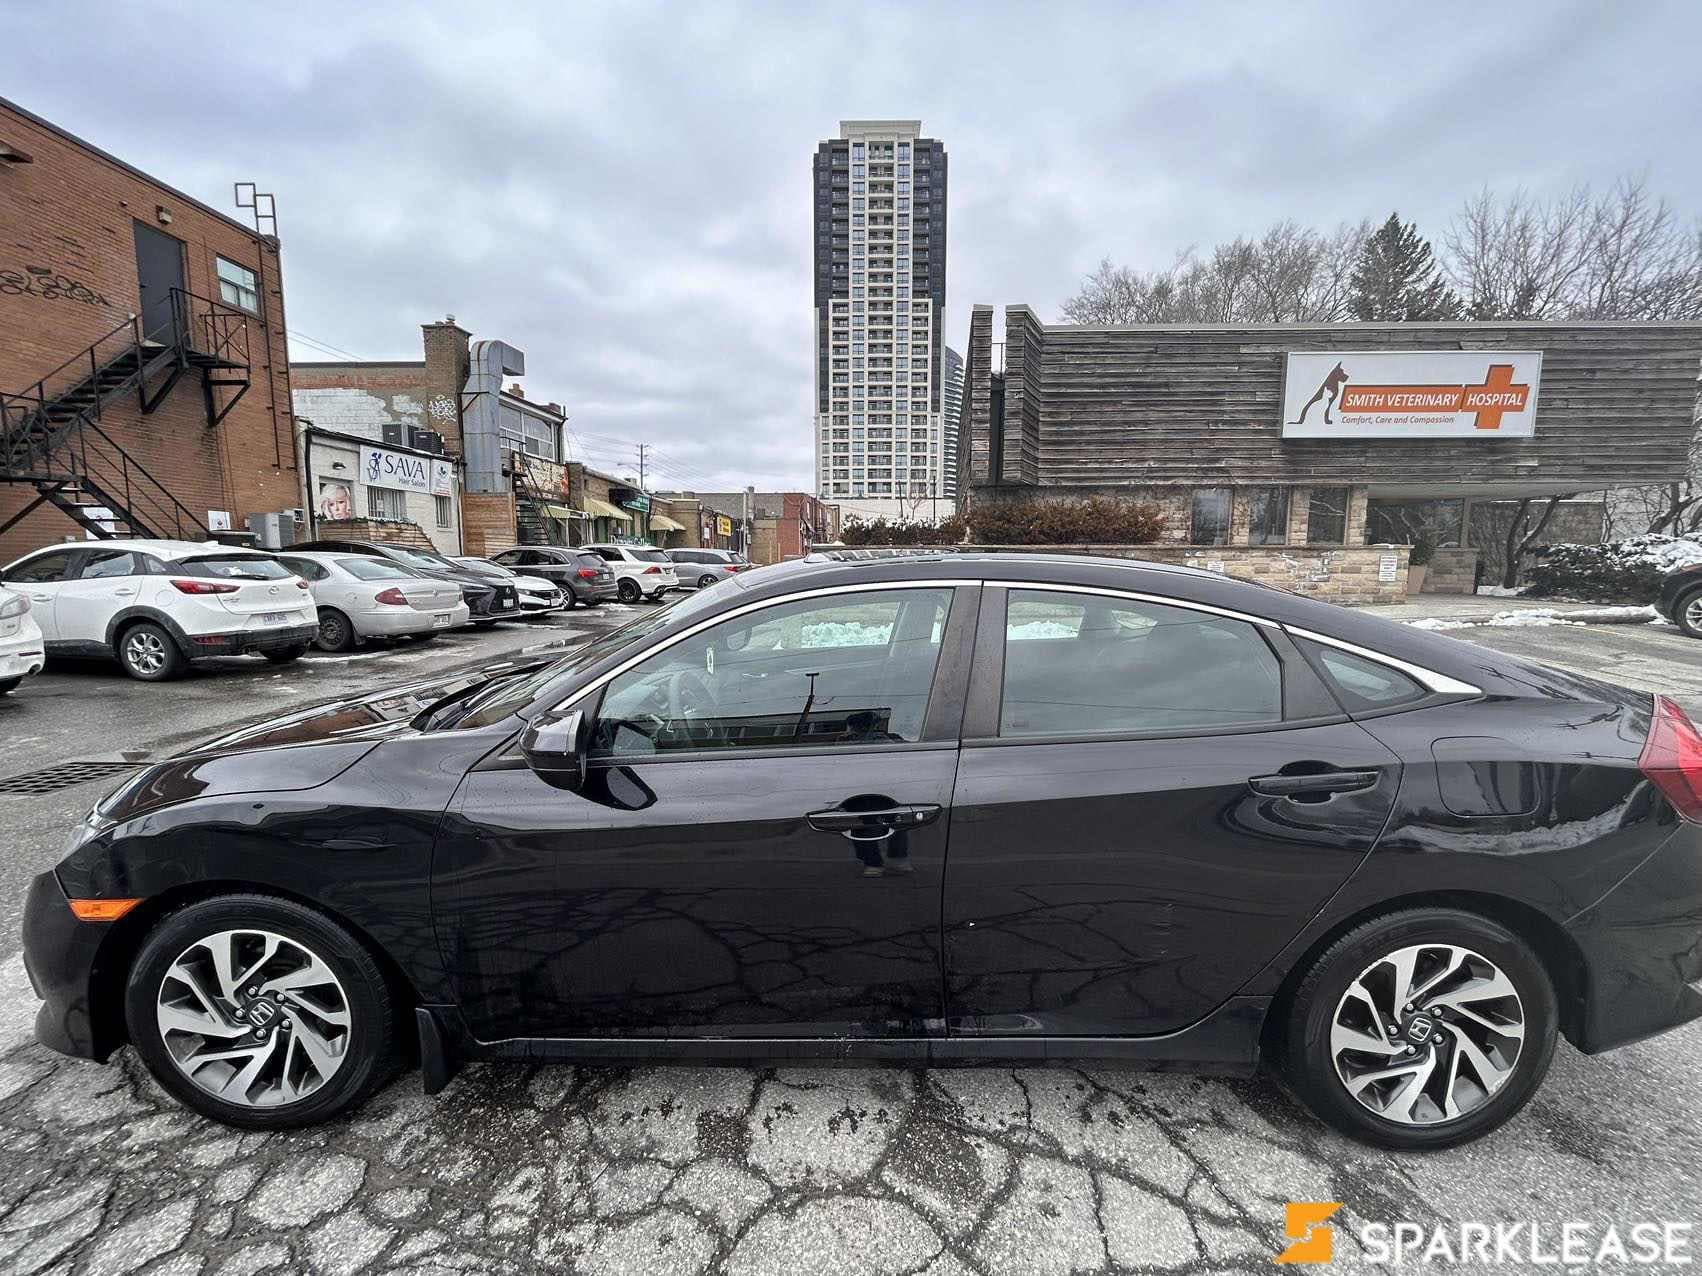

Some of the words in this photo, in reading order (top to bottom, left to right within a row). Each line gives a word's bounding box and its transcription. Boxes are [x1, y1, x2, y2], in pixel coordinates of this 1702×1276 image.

[1346, 393, 1385, 407] SMITH
[1387, 393, 1459, 407] VETERINARY
[1466, 393, 1523, 406] HOSPITAL
[1341, 415, 1373, 425] Comfort,
[1375, 415, 1392, 424] Care
[1393, 415, 1408, 424] and
[1409, 415, 1455, 425] Compassion
[384, 454, 425, 480] SAVA
[411, 478, 426, 488] Salon
